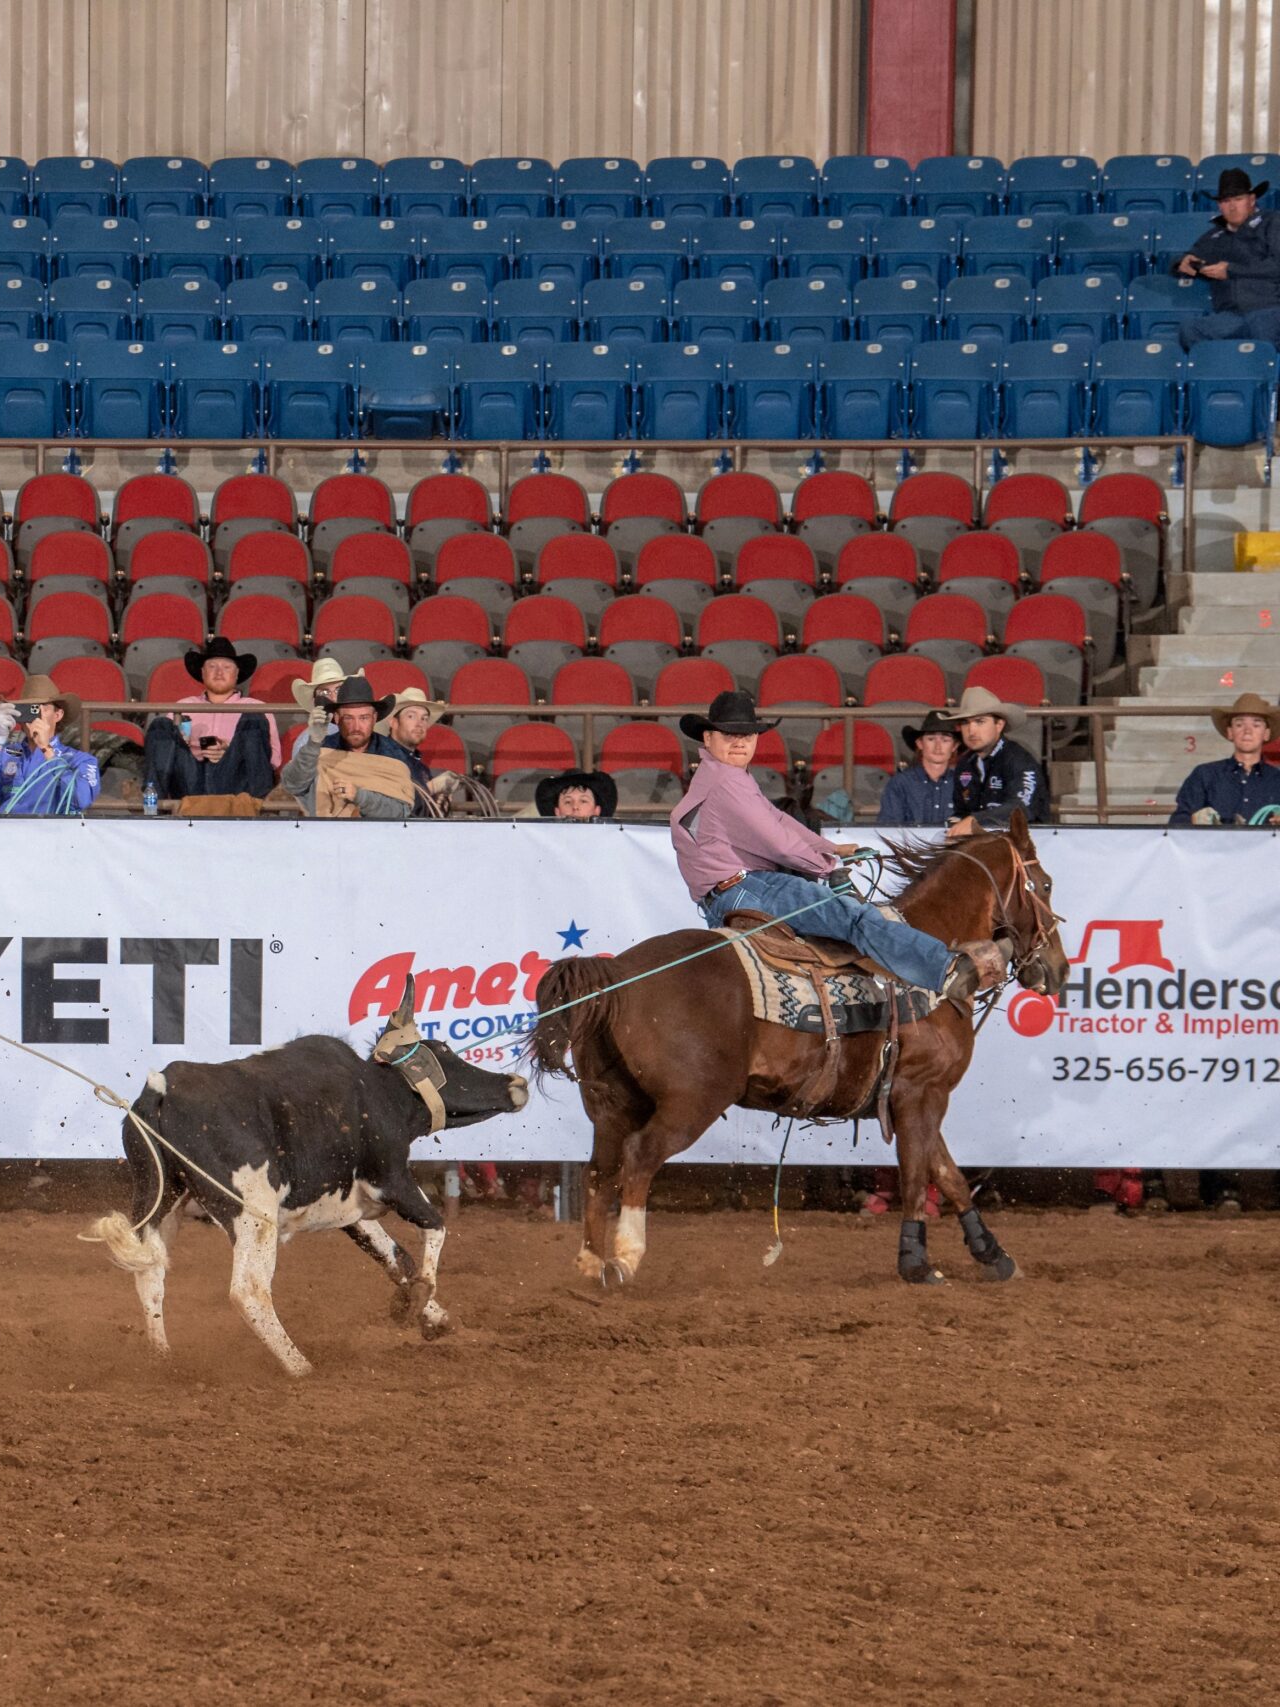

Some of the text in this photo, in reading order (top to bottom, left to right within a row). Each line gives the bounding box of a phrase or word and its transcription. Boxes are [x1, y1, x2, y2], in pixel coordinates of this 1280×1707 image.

[1258, 609, 1272, 628] 5
[1220, 671, 1234, 688] 4
[1184, 736, 1196, 753] 3
[1056, 1012, 1147, 1034] Tractor
[1155, 1013, 1174, 1034] &
[464, 1047, 505, 1065] 1915
[1052, 1056, 1280, 1083] 325-656-7912
